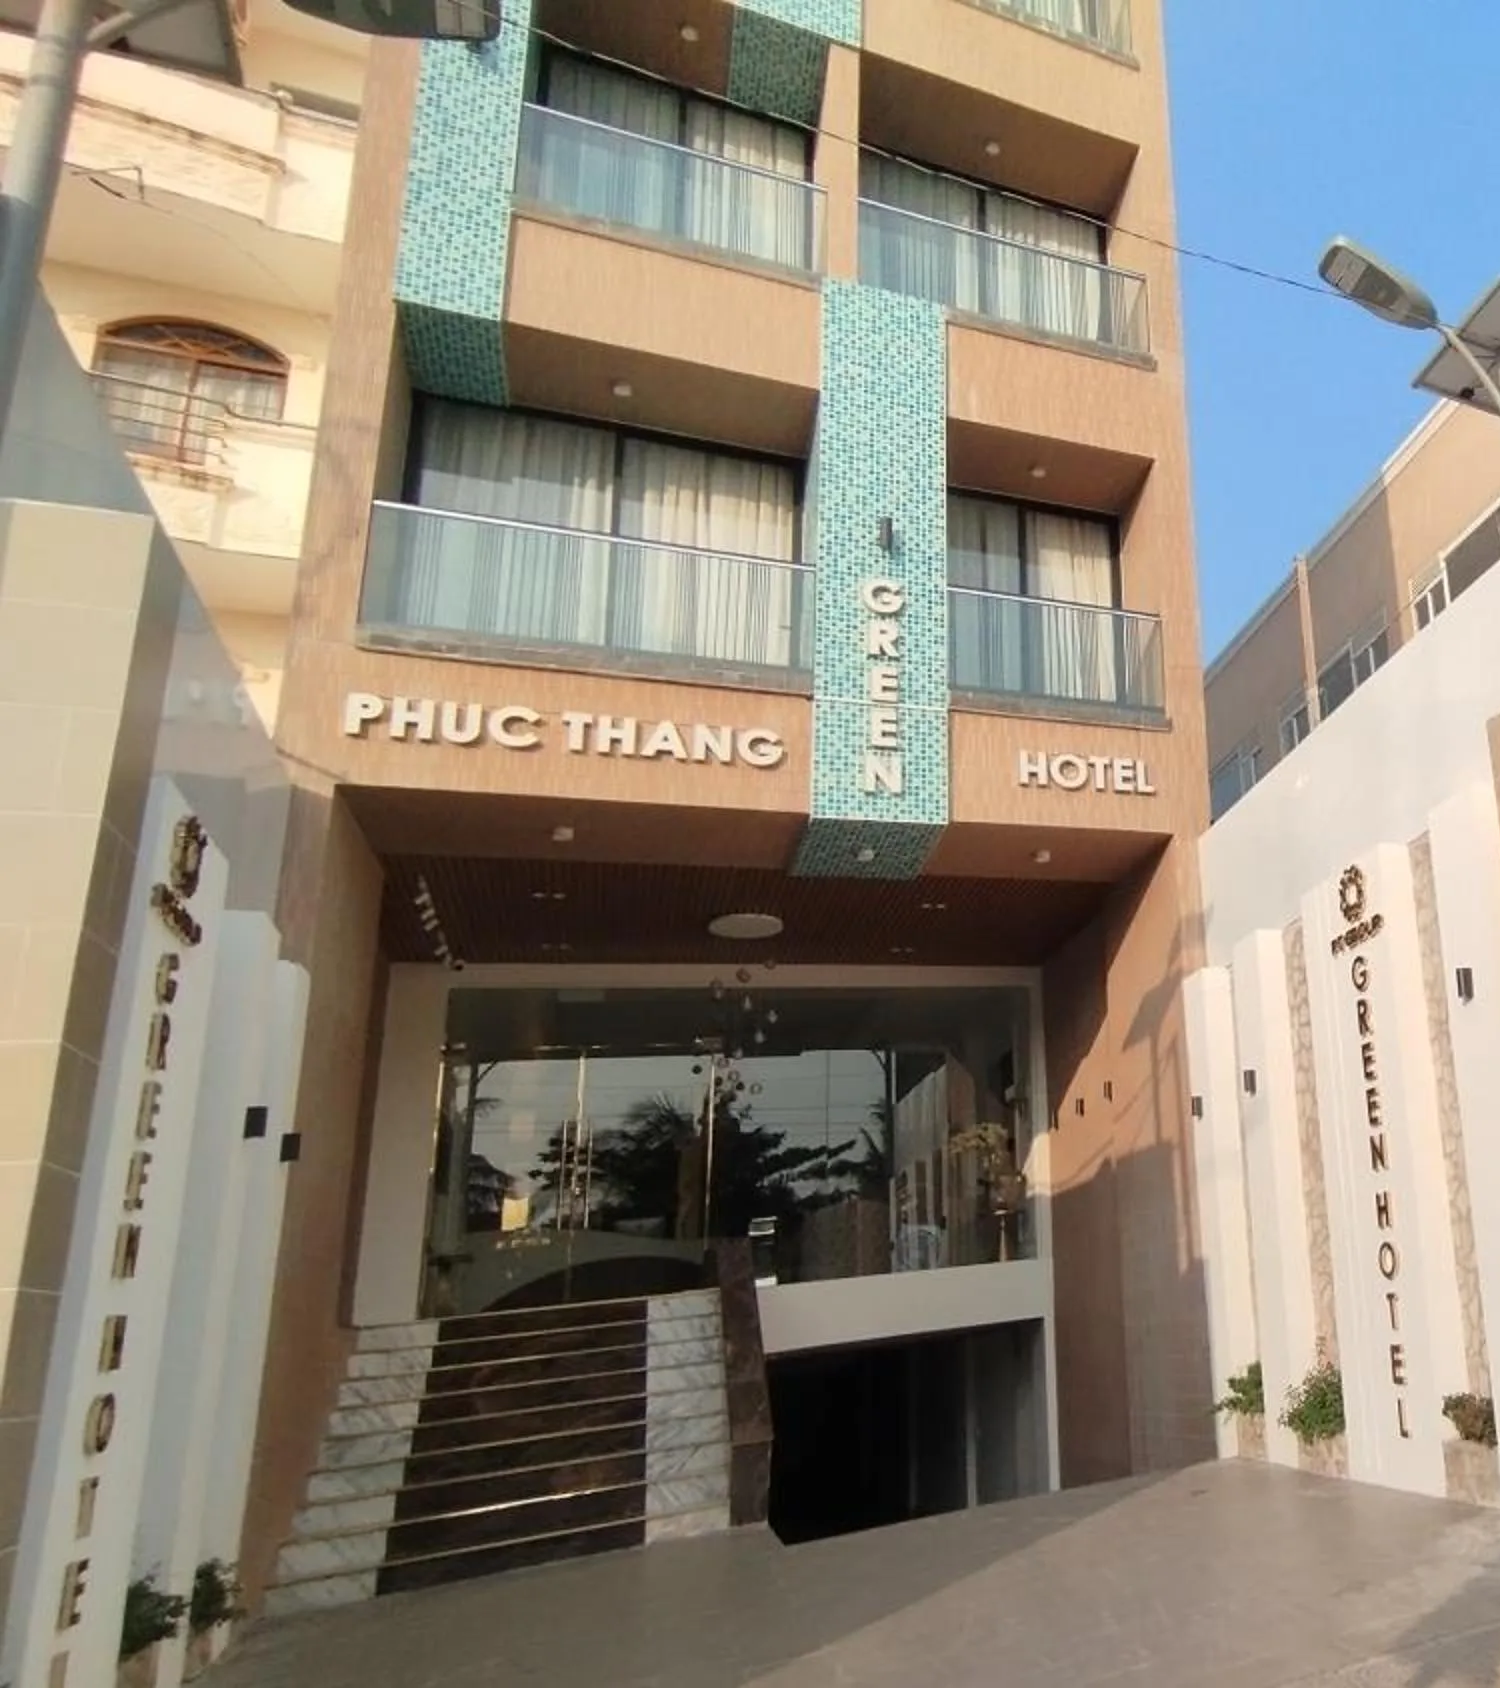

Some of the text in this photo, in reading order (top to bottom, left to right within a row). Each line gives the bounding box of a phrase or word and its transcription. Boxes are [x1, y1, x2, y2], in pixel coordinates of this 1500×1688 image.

[342, 691, 787, 770] PHUC THANG
[860, 581, 906, 796] GREEN
[1017, 749, 1157, 797] HOTEL
[1351, 955, 1390, 1175] GREEN
[1375, 1190, 1413, 1440] HOTEL
